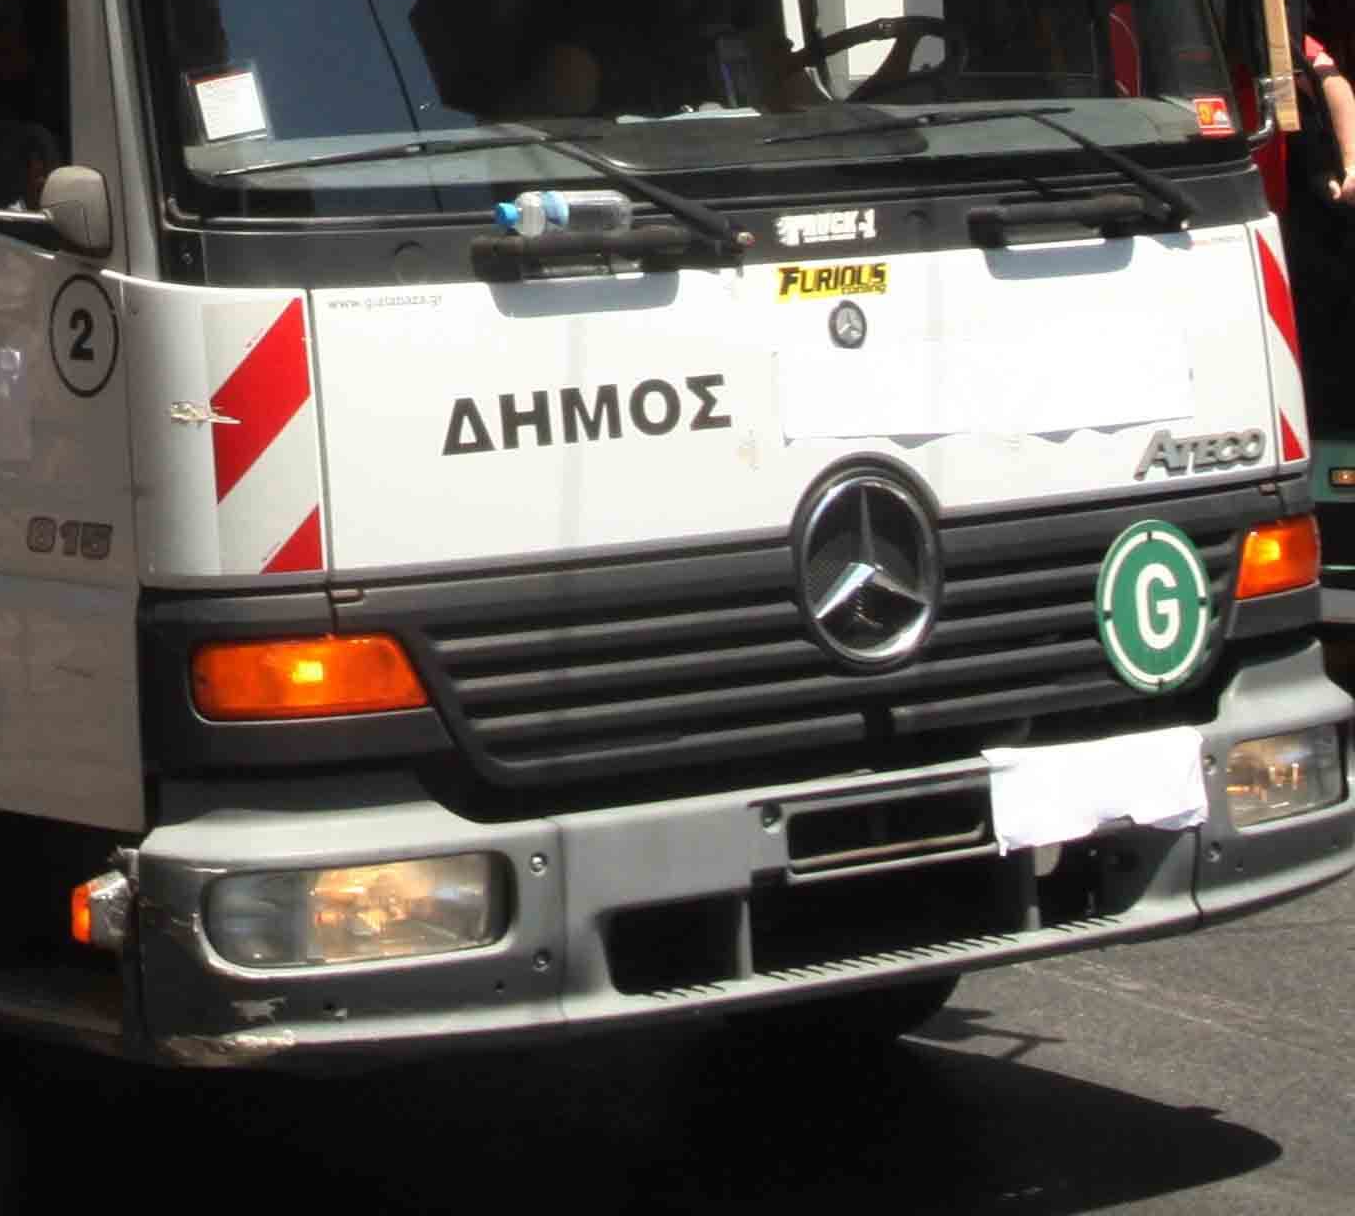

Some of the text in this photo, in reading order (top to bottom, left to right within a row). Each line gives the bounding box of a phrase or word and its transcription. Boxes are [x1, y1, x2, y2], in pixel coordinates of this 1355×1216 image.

[68, 307, 95, 361] 2
[441, 373, 732, 456] ΔΗΜΟΣ
[1134, 562, 1181, 650] G
